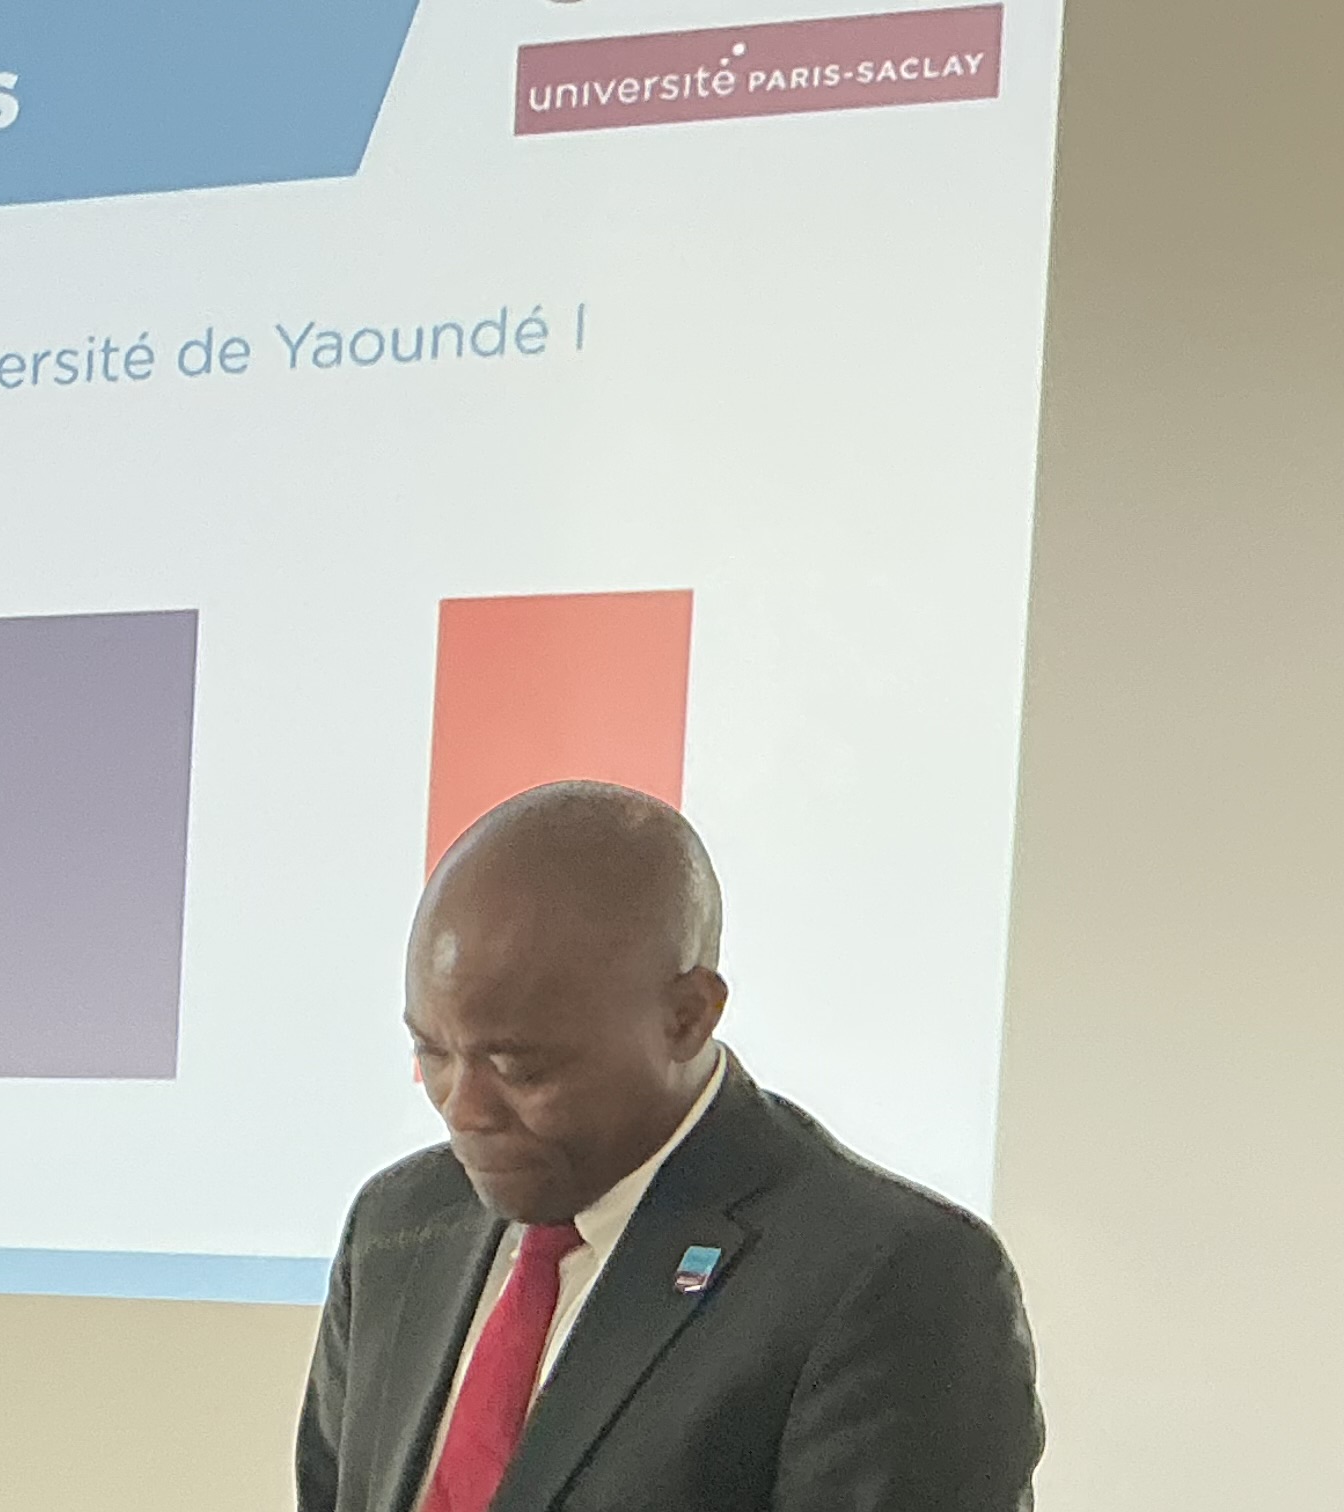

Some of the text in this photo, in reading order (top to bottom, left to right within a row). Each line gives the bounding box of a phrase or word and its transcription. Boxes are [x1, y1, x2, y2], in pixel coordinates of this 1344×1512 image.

[528, 42, 985, 112] université PARIS-SACLAY
[177, 326, 251, 378] de
[275, 304, 549, 369] Yaoundé
